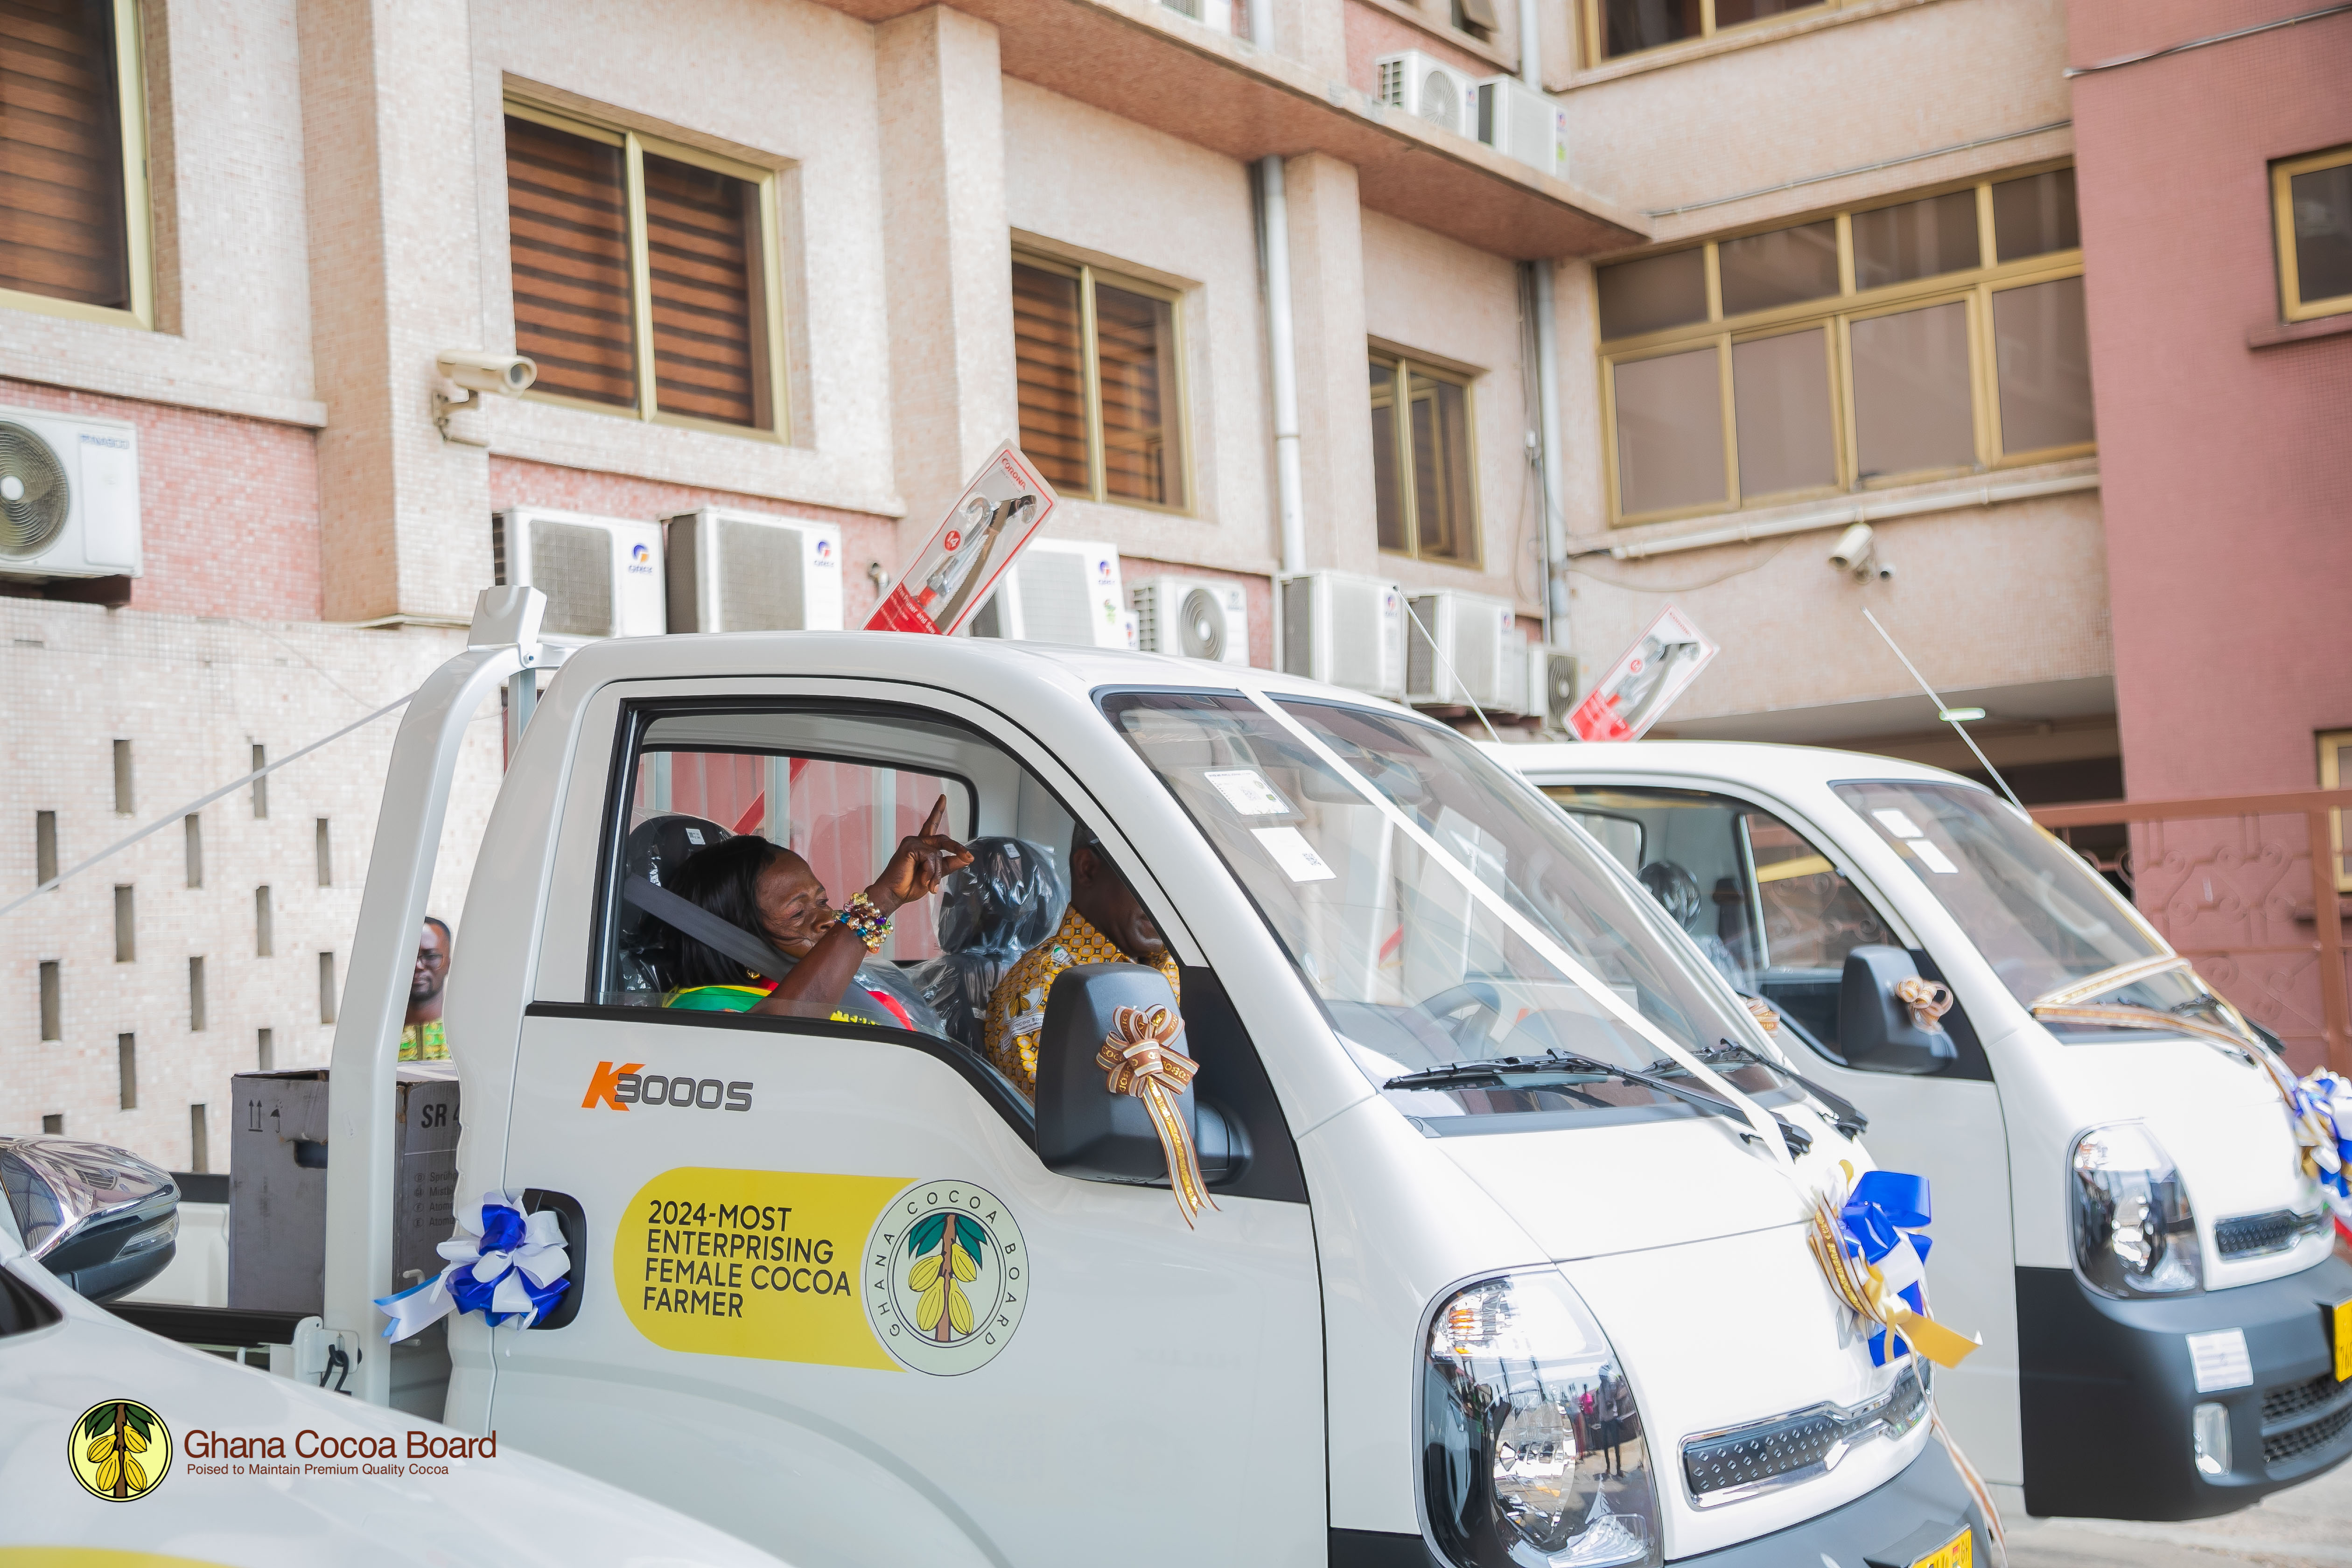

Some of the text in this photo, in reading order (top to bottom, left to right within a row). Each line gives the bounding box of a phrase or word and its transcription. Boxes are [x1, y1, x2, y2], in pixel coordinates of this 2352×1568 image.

[1002, 458, 1026, 490] CORONA
[903, 595, 918, 614] Pruner
[917, 612, 928, 624] and
[925, 621, 936, 634] Saw
[581, 1062, 754, 1112] K3000S
[421, 1104, 448, 1128] SR
[648, 1200, 792, 1232] 2024-MOST
[647, 1228, 834, 1265] ENTERPRISING
[645, 1257, 851, 1296] FEMALE COCOA
[874, 1190, 1020, 1345] GHANA COCOA BOARD
[644, 1286, 743, 1318] FARMER
